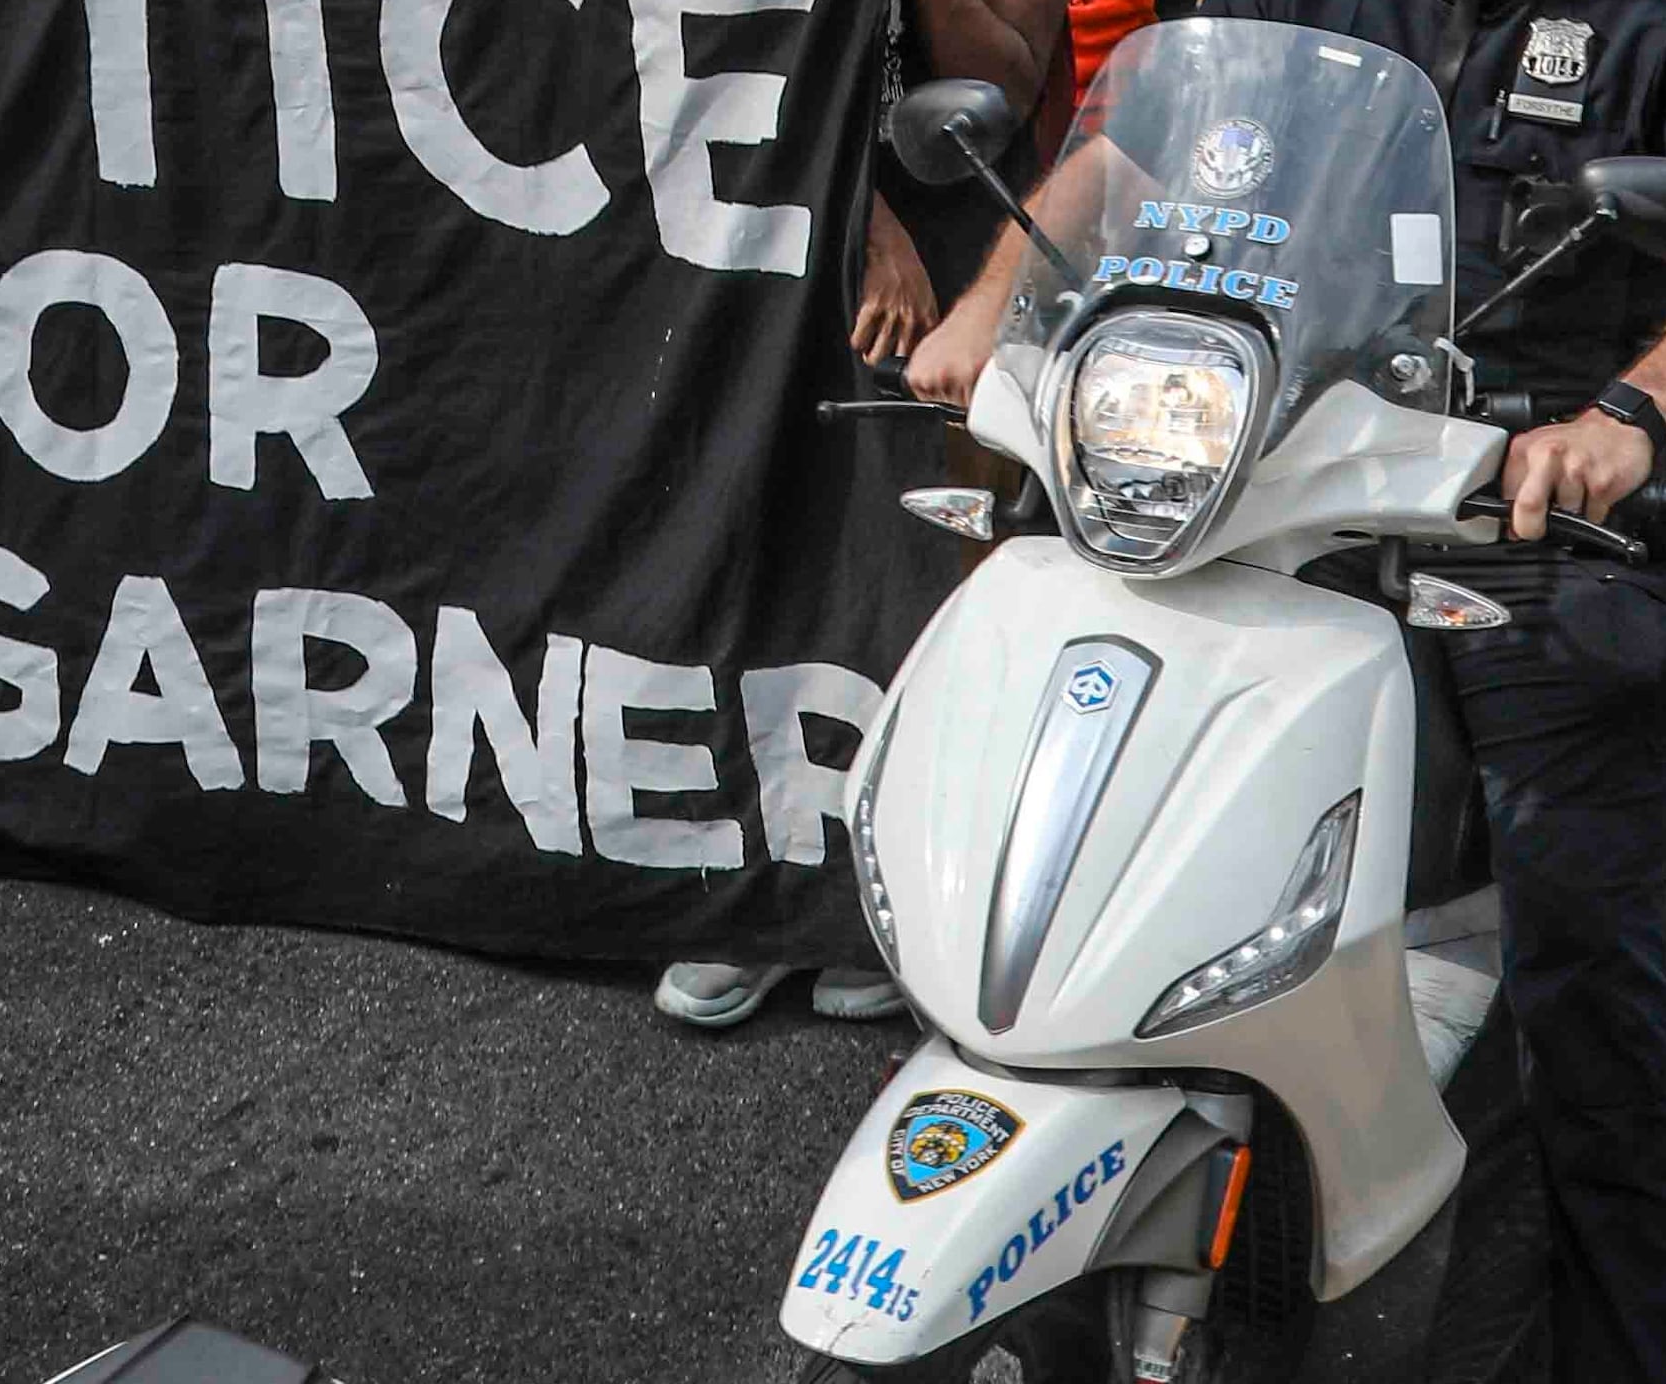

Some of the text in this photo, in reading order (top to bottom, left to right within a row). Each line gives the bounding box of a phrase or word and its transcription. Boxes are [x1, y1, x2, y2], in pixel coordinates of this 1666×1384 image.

[1134, 199, 1292, 246] NYPD
[1093, 255, 1300, 310] POLICE
[906, 1105, 1010, 1143] DEPARTMENT
[935, 1092, 1001, 1120] POLICE
[919, 1146, 999, 1194] NEW YORK
[966, 1138, 1127, 1325] POLICE
[797, 1228, 920, 1322] 2414 15
